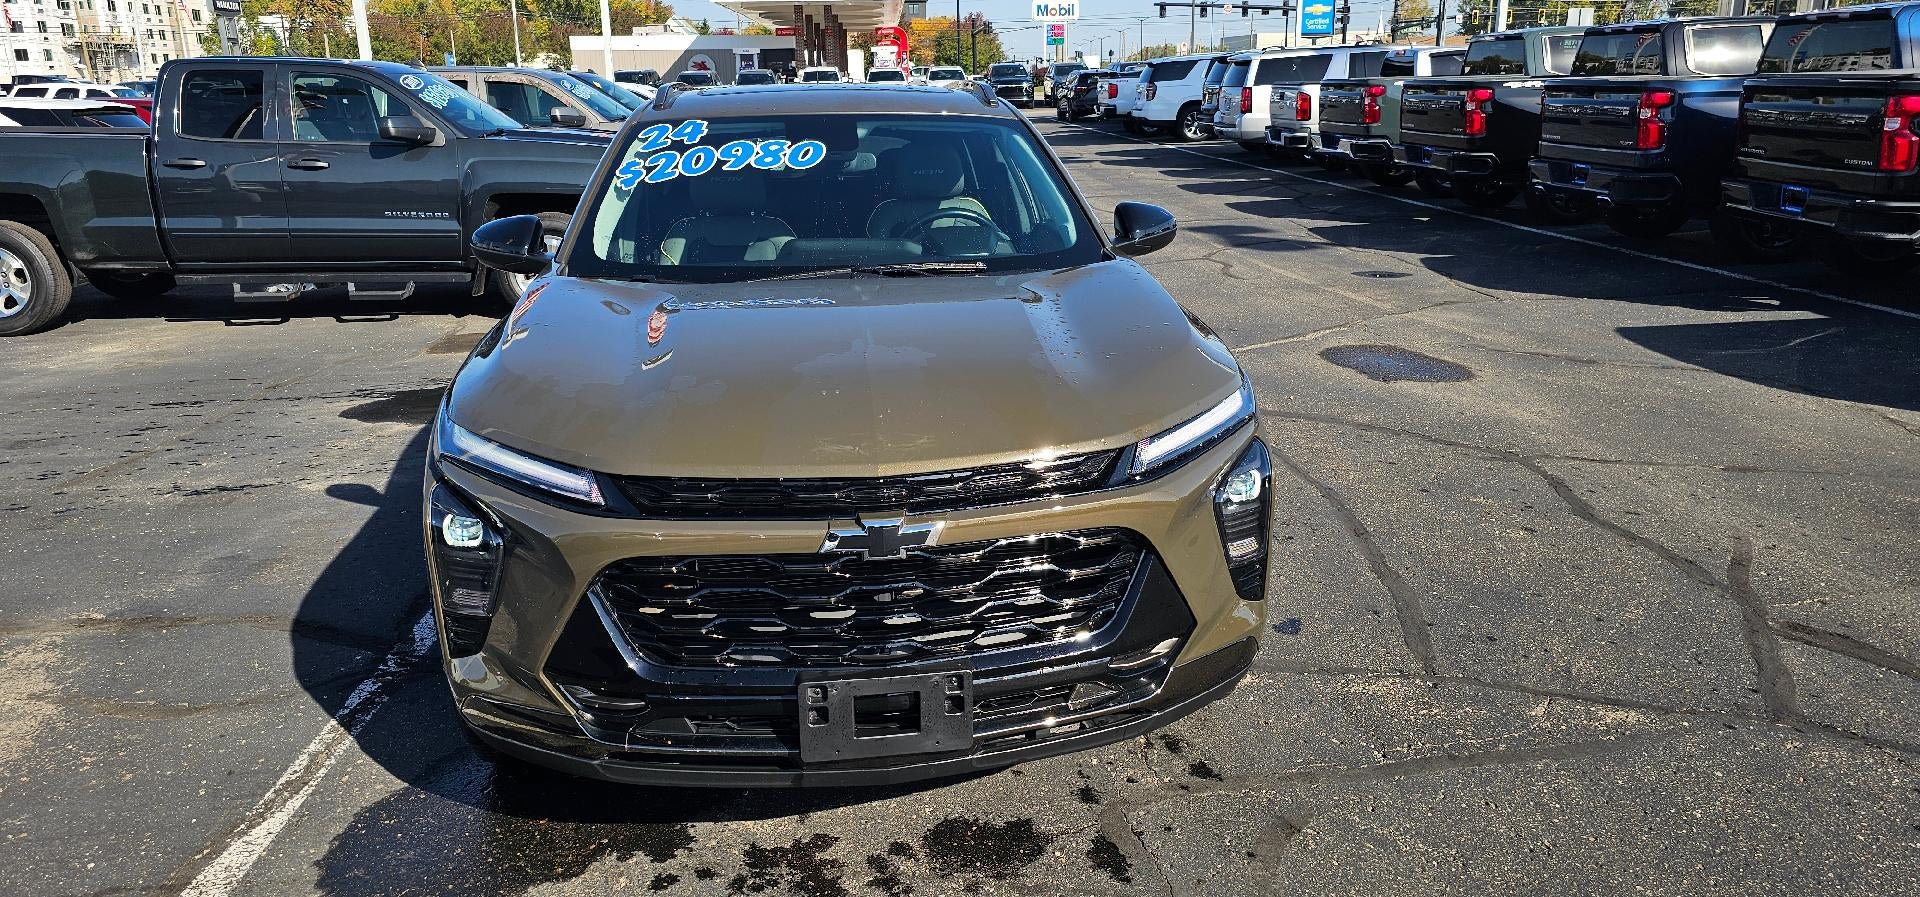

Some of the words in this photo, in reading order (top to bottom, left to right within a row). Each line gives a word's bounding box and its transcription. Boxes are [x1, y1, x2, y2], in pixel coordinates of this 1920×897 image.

[1036, 3, 1075, 17] Mobil
[1305, 17, 1330, 25] Certified
[638, 119, 709, 152] 24
[615, 139, 827, 190] $20980
[1844, 158, 1873, 166] CUSTOM
